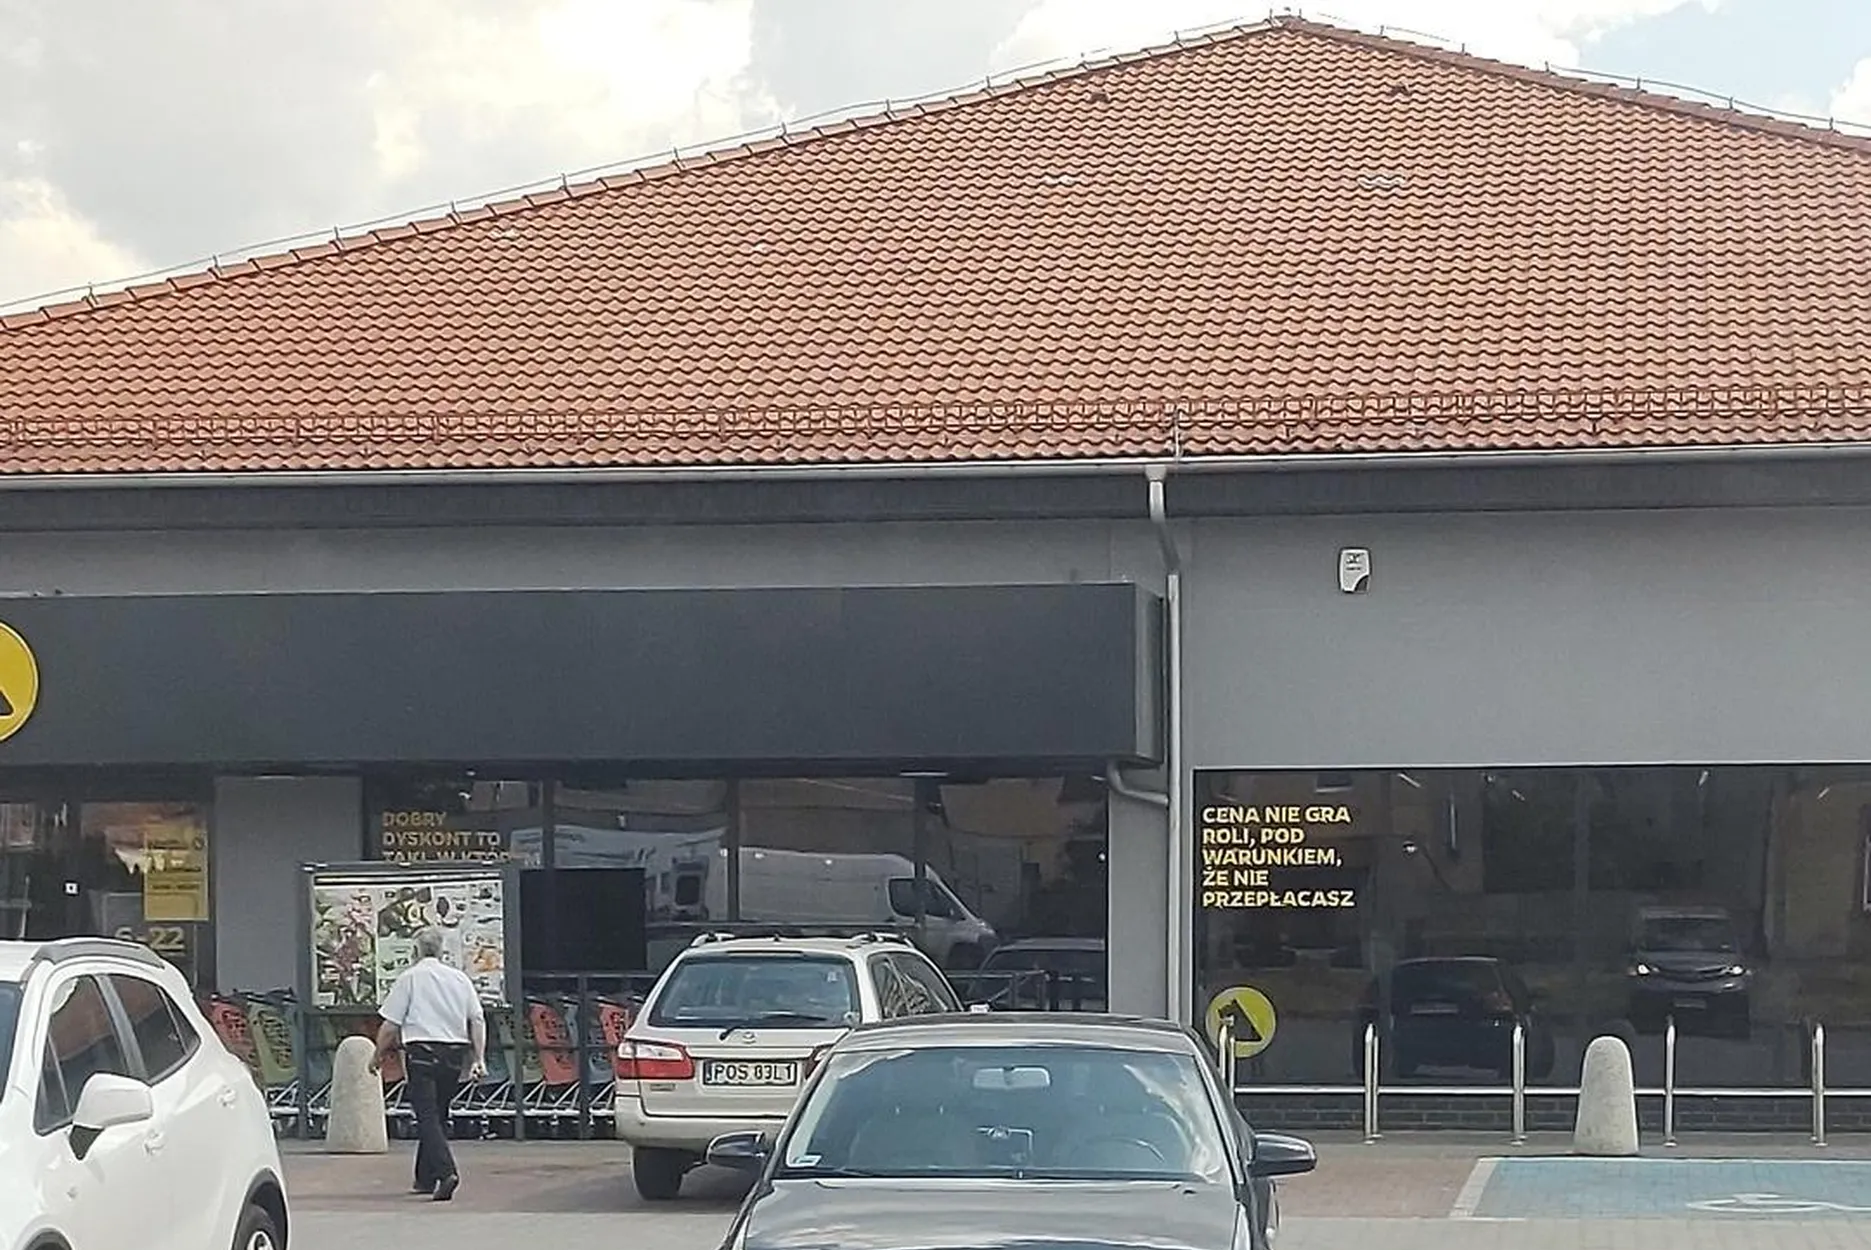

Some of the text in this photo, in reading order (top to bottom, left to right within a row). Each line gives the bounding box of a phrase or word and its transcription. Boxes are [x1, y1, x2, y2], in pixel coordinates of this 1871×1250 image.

[382, 811, 446, 827] DOBRY
[1202, 806, 1351, 823] CENA NIE GRA
[382, 831, 500, 846] DYSKONT TO
[1202, 828, 1305, 848] ROLI, POD
[1202, 849, 1343, 867] WARUNKIEM,
[1202, 866, 1269, 886] ŻE NIE
[1202, 891, 1355, 908] PRZEPŁACASZ
[714, 1064, 749, 1080] POS
